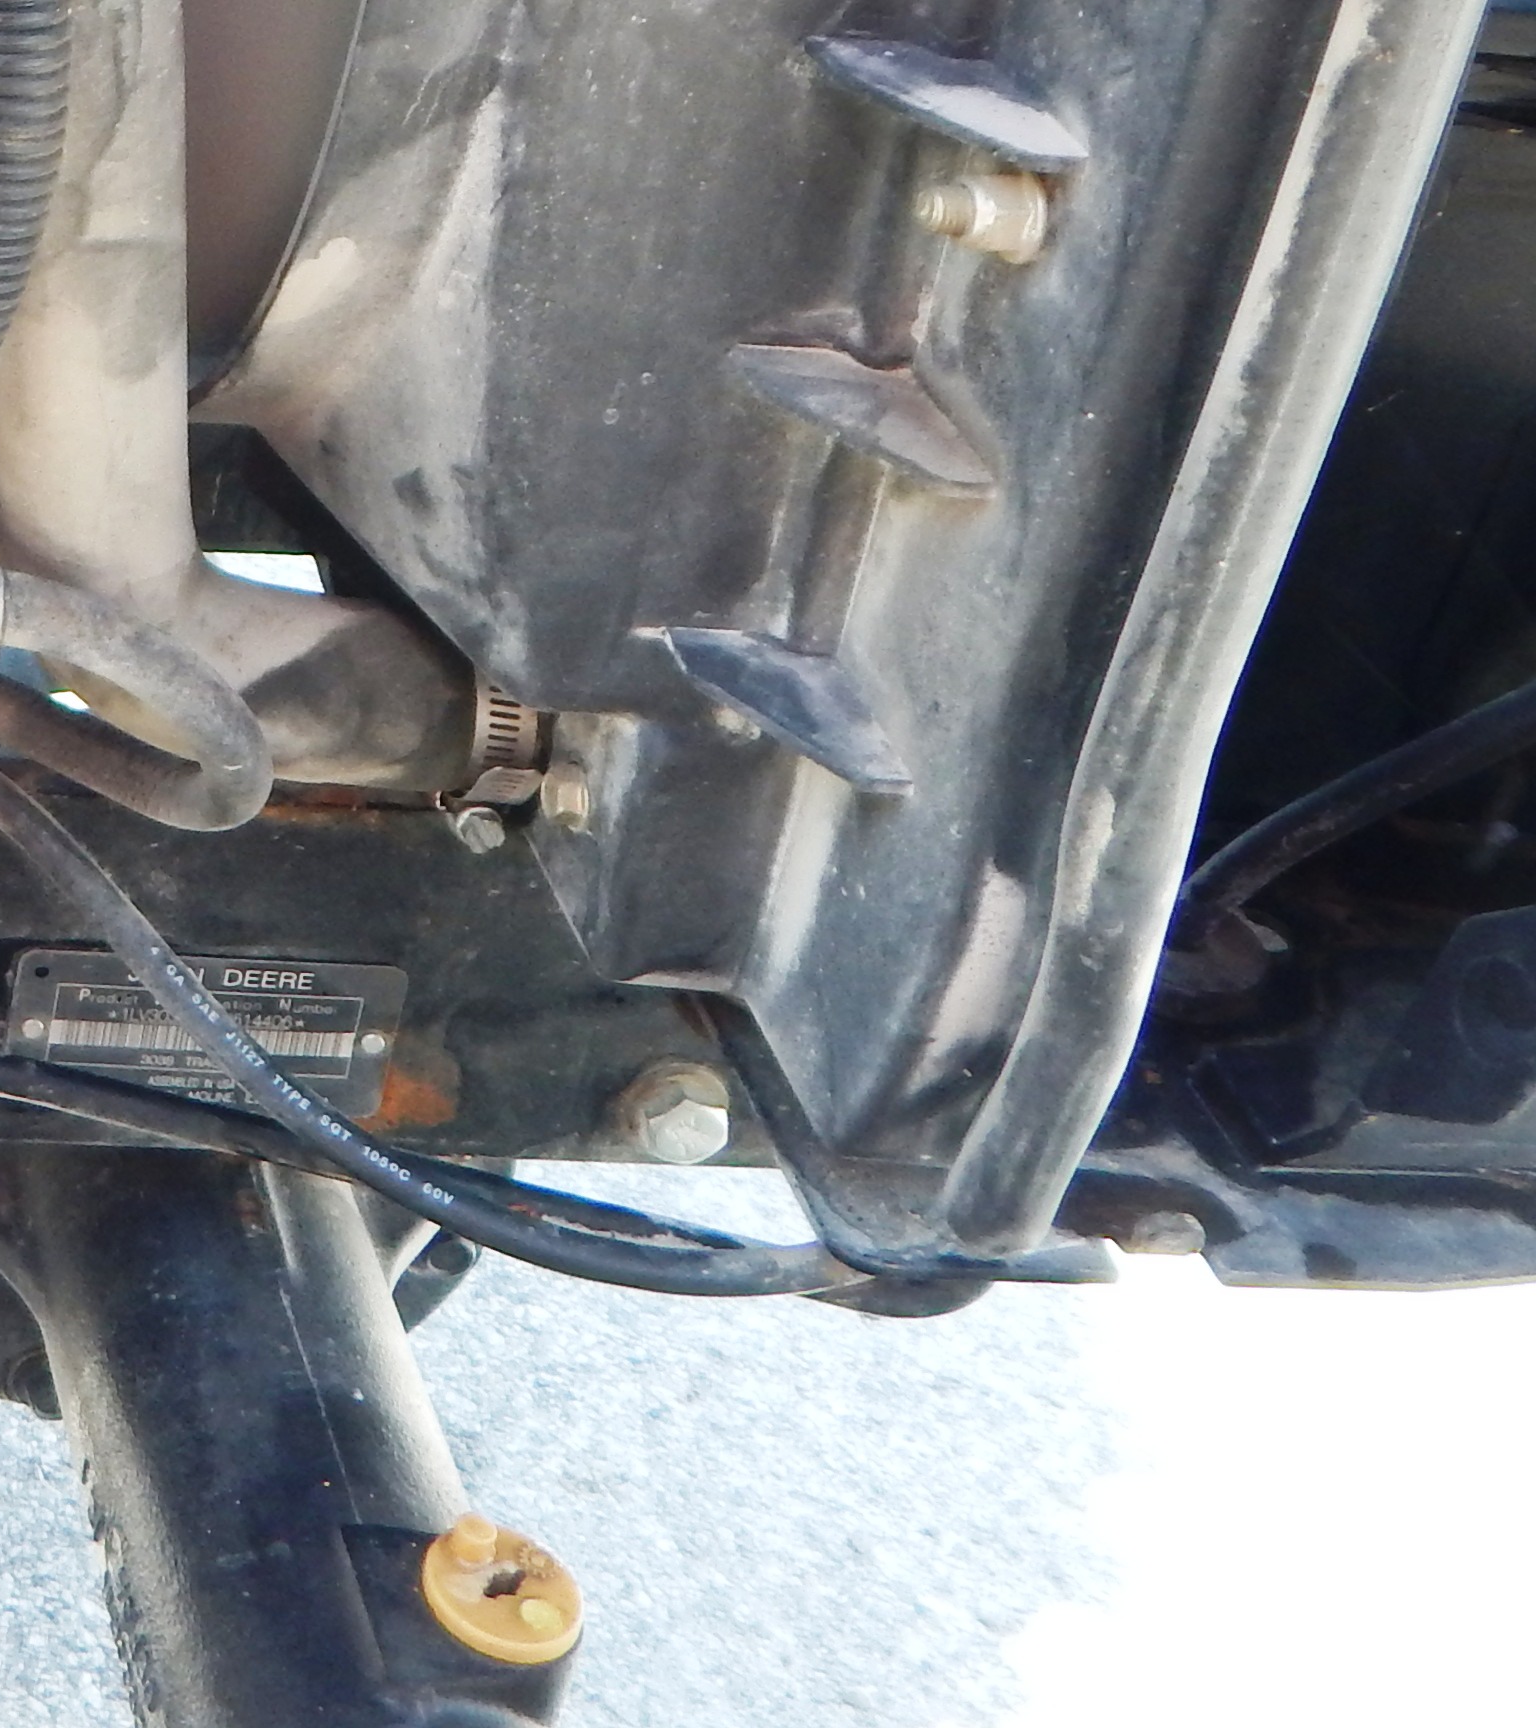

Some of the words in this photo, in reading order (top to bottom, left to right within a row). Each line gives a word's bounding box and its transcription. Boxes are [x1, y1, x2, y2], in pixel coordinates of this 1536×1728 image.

[222, 968, 316, 991] DEERE
[191, 992, 220, 1024] SAE
[271, 1073, 311, 1111] TYPE
[319, 1114, 353, 1143] SGT
[421, 1181, 455, 1206] 60V
